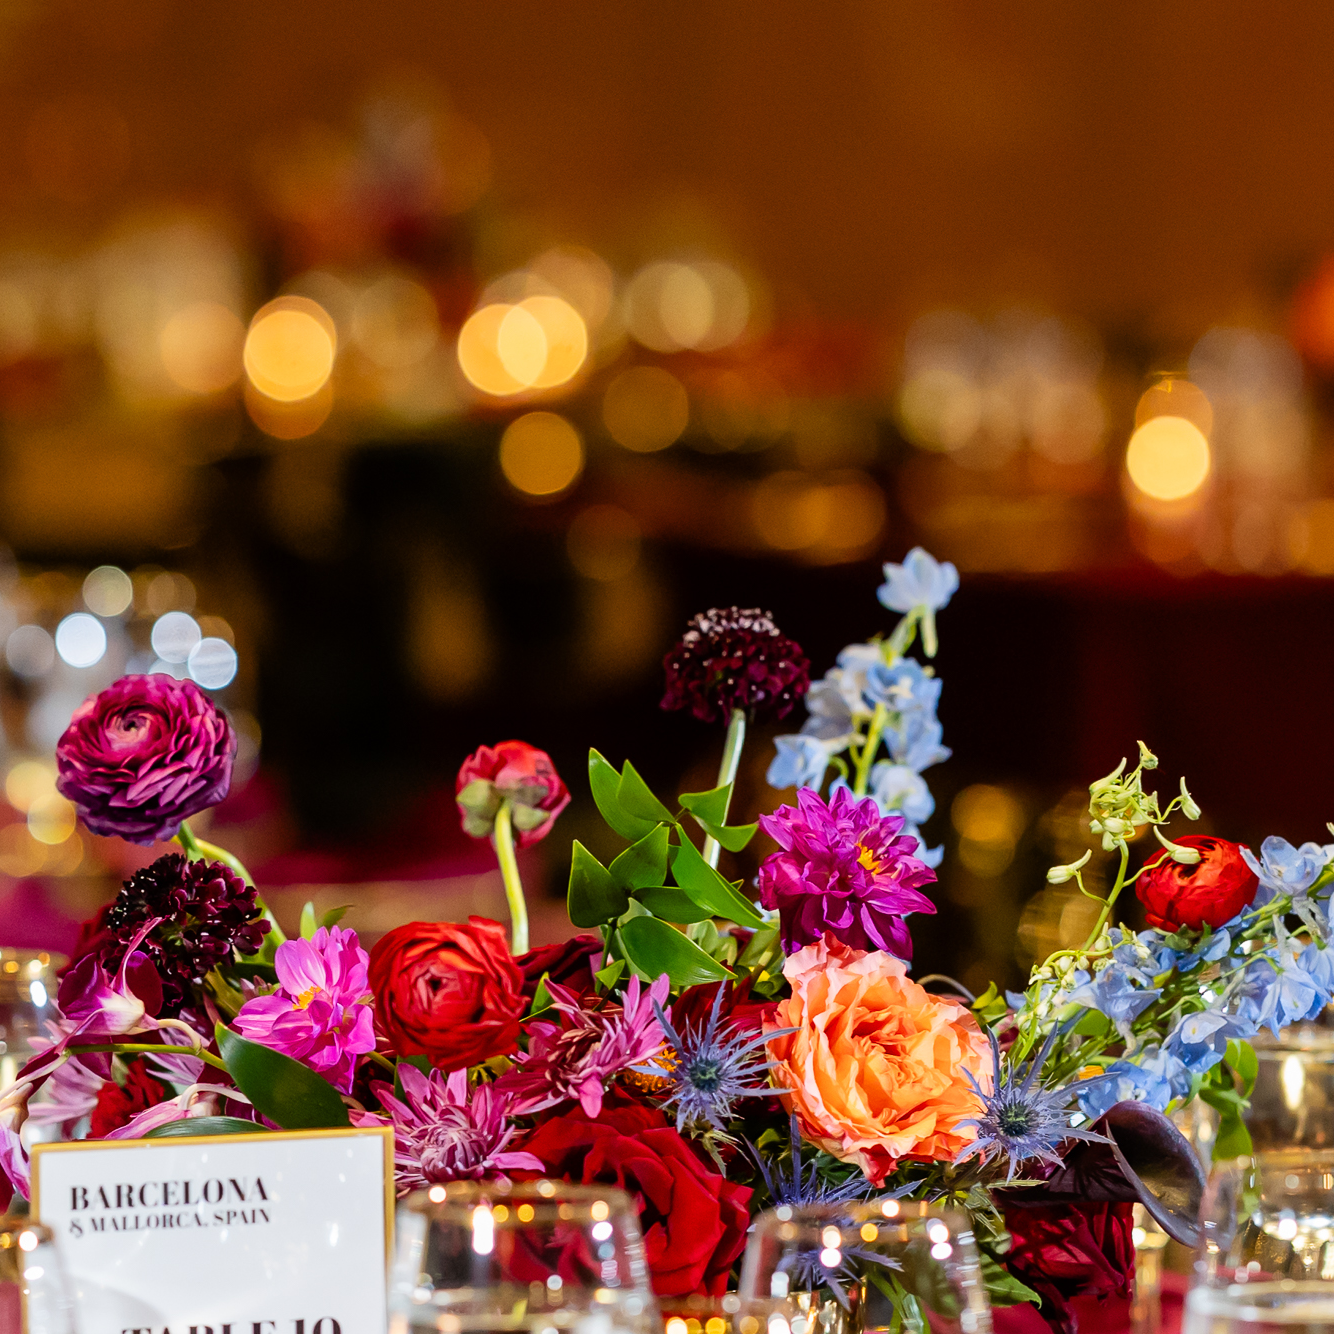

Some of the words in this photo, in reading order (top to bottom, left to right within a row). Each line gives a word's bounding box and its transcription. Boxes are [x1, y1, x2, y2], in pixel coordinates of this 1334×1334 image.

[70, 1176, 271, 1211] BARCELONA
[69, 1218, 84, 1239] &
[213, 1208, 271, 1227] SPAIN
